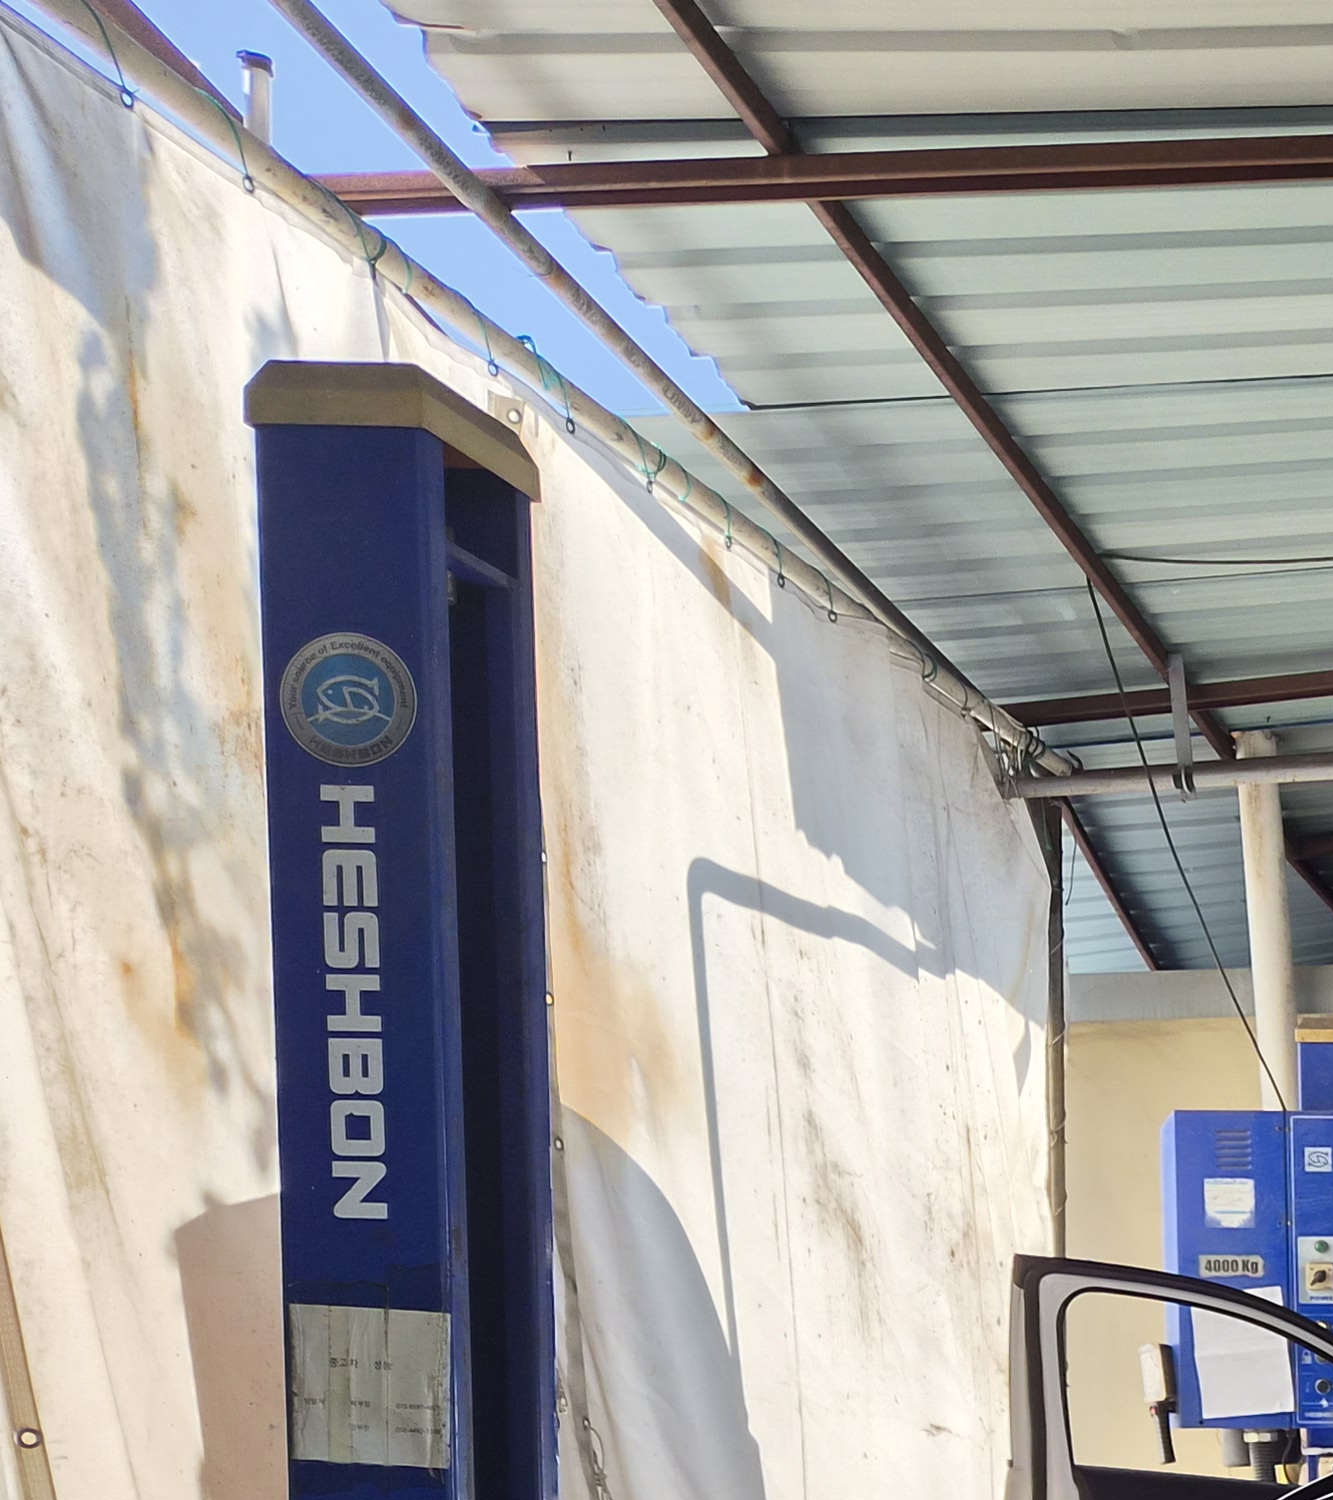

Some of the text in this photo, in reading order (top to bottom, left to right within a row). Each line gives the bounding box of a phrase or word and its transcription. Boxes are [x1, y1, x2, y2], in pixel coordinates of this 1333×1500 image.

[330, 640, 381, 660] Excellent
[319, 783, 390, 1222] HESHBON
[1204, 1258, 1260, 1275] 4000 Kg
